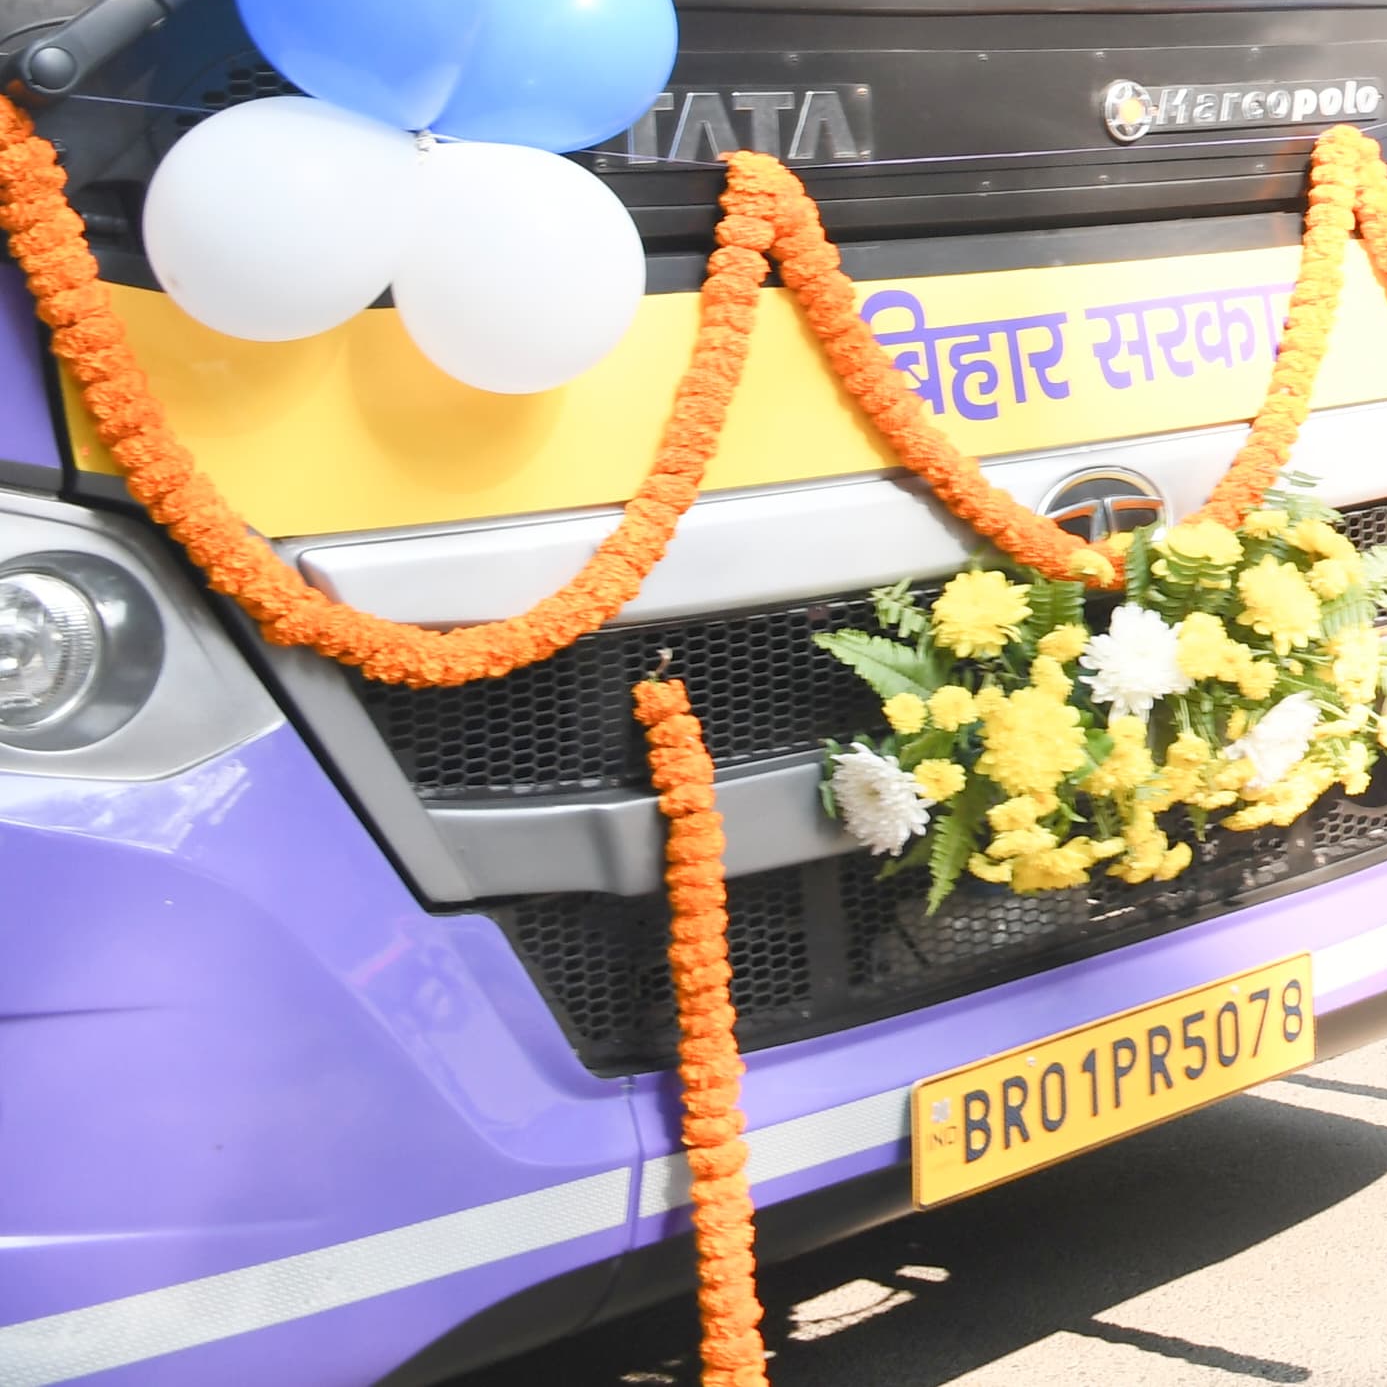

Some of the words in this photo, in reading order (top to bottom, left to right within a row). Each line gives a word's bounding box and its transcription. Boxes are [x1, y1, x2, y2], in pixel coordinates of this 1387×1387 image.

[627, 91, 857, 164] TATA
[1155, 80, 1380, 126] Marcopolo
[861, 290, 1069, 420] बिहार
[1085, 282, 1296, 390] सरका
[963, 979, 1302, 1163] BR01PR5078
